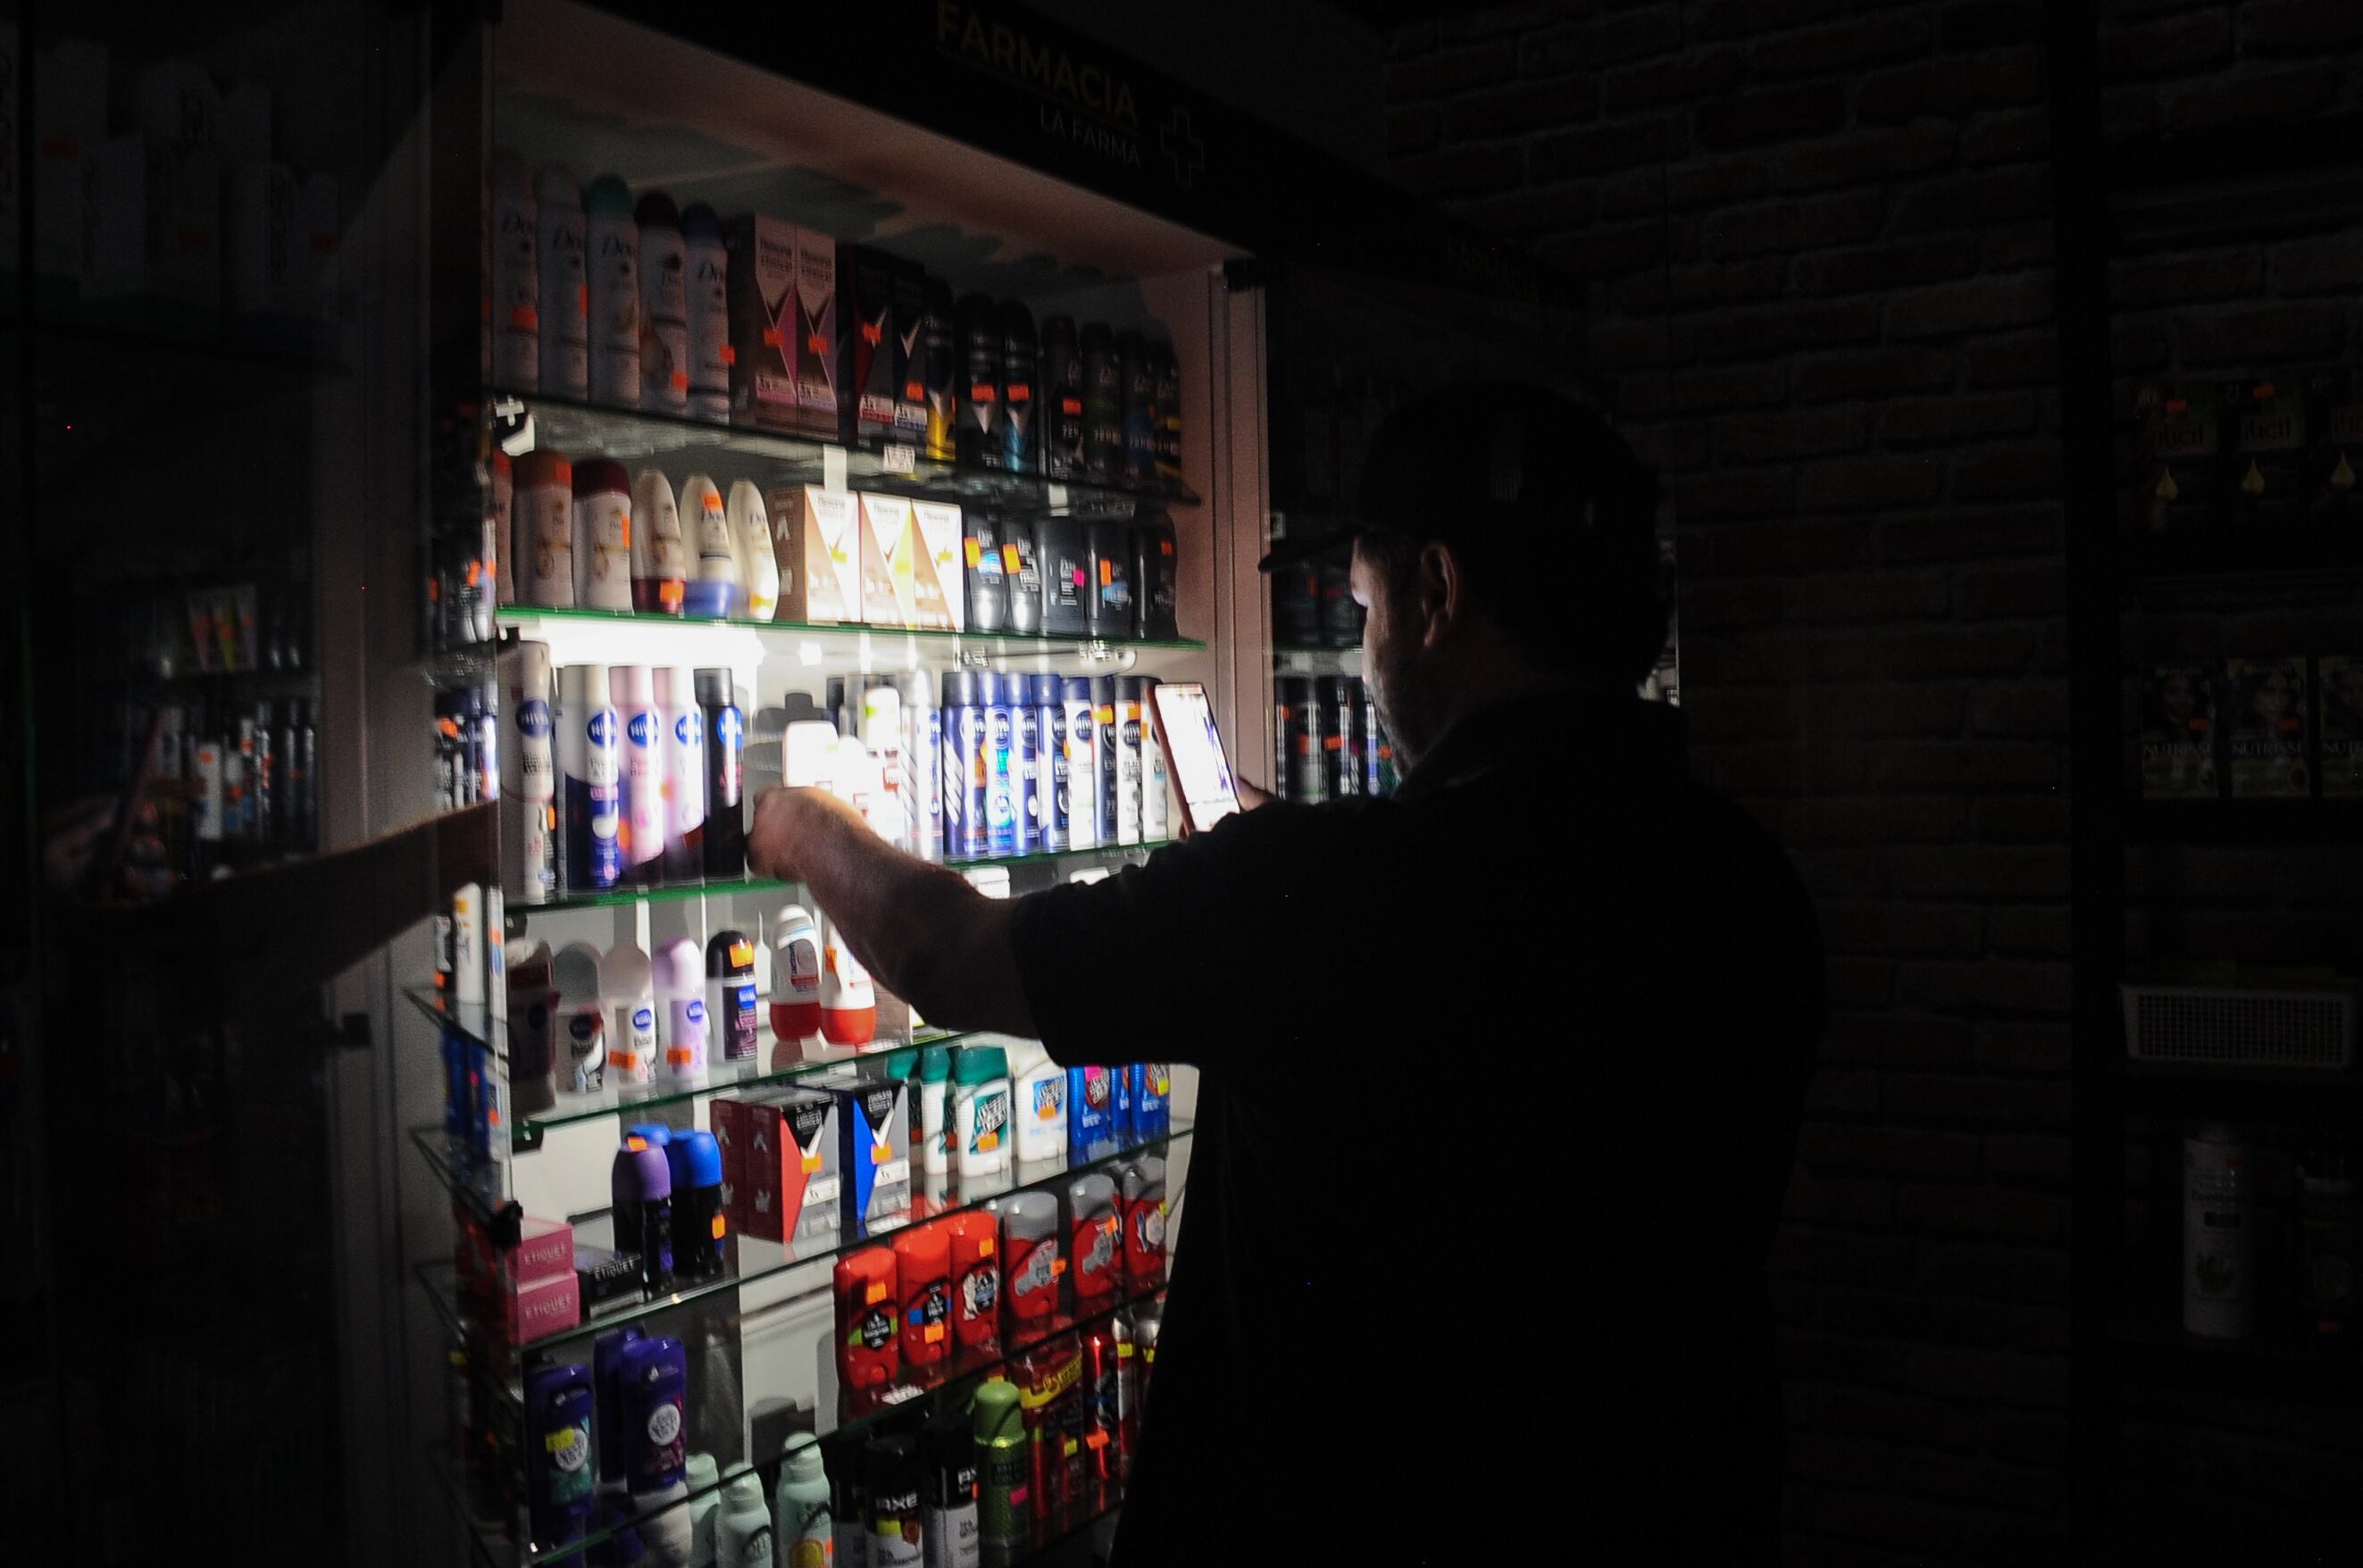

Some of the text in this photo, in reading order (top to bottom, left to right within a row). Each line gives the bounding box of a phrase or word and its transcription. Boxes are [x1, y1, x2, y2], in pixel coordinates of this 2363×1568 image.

[936, 0, 1141, 129] FARMACIA
[1039, 102, 1143, 171] LA FARMA
[524, 1243, 567, 1265] ETIQUET
[594, 1258, 636, 1280] ETIQUET
[525, 1295, 573, 1320] ETIQUET
[876, 1489, 918, 1511] AXE
